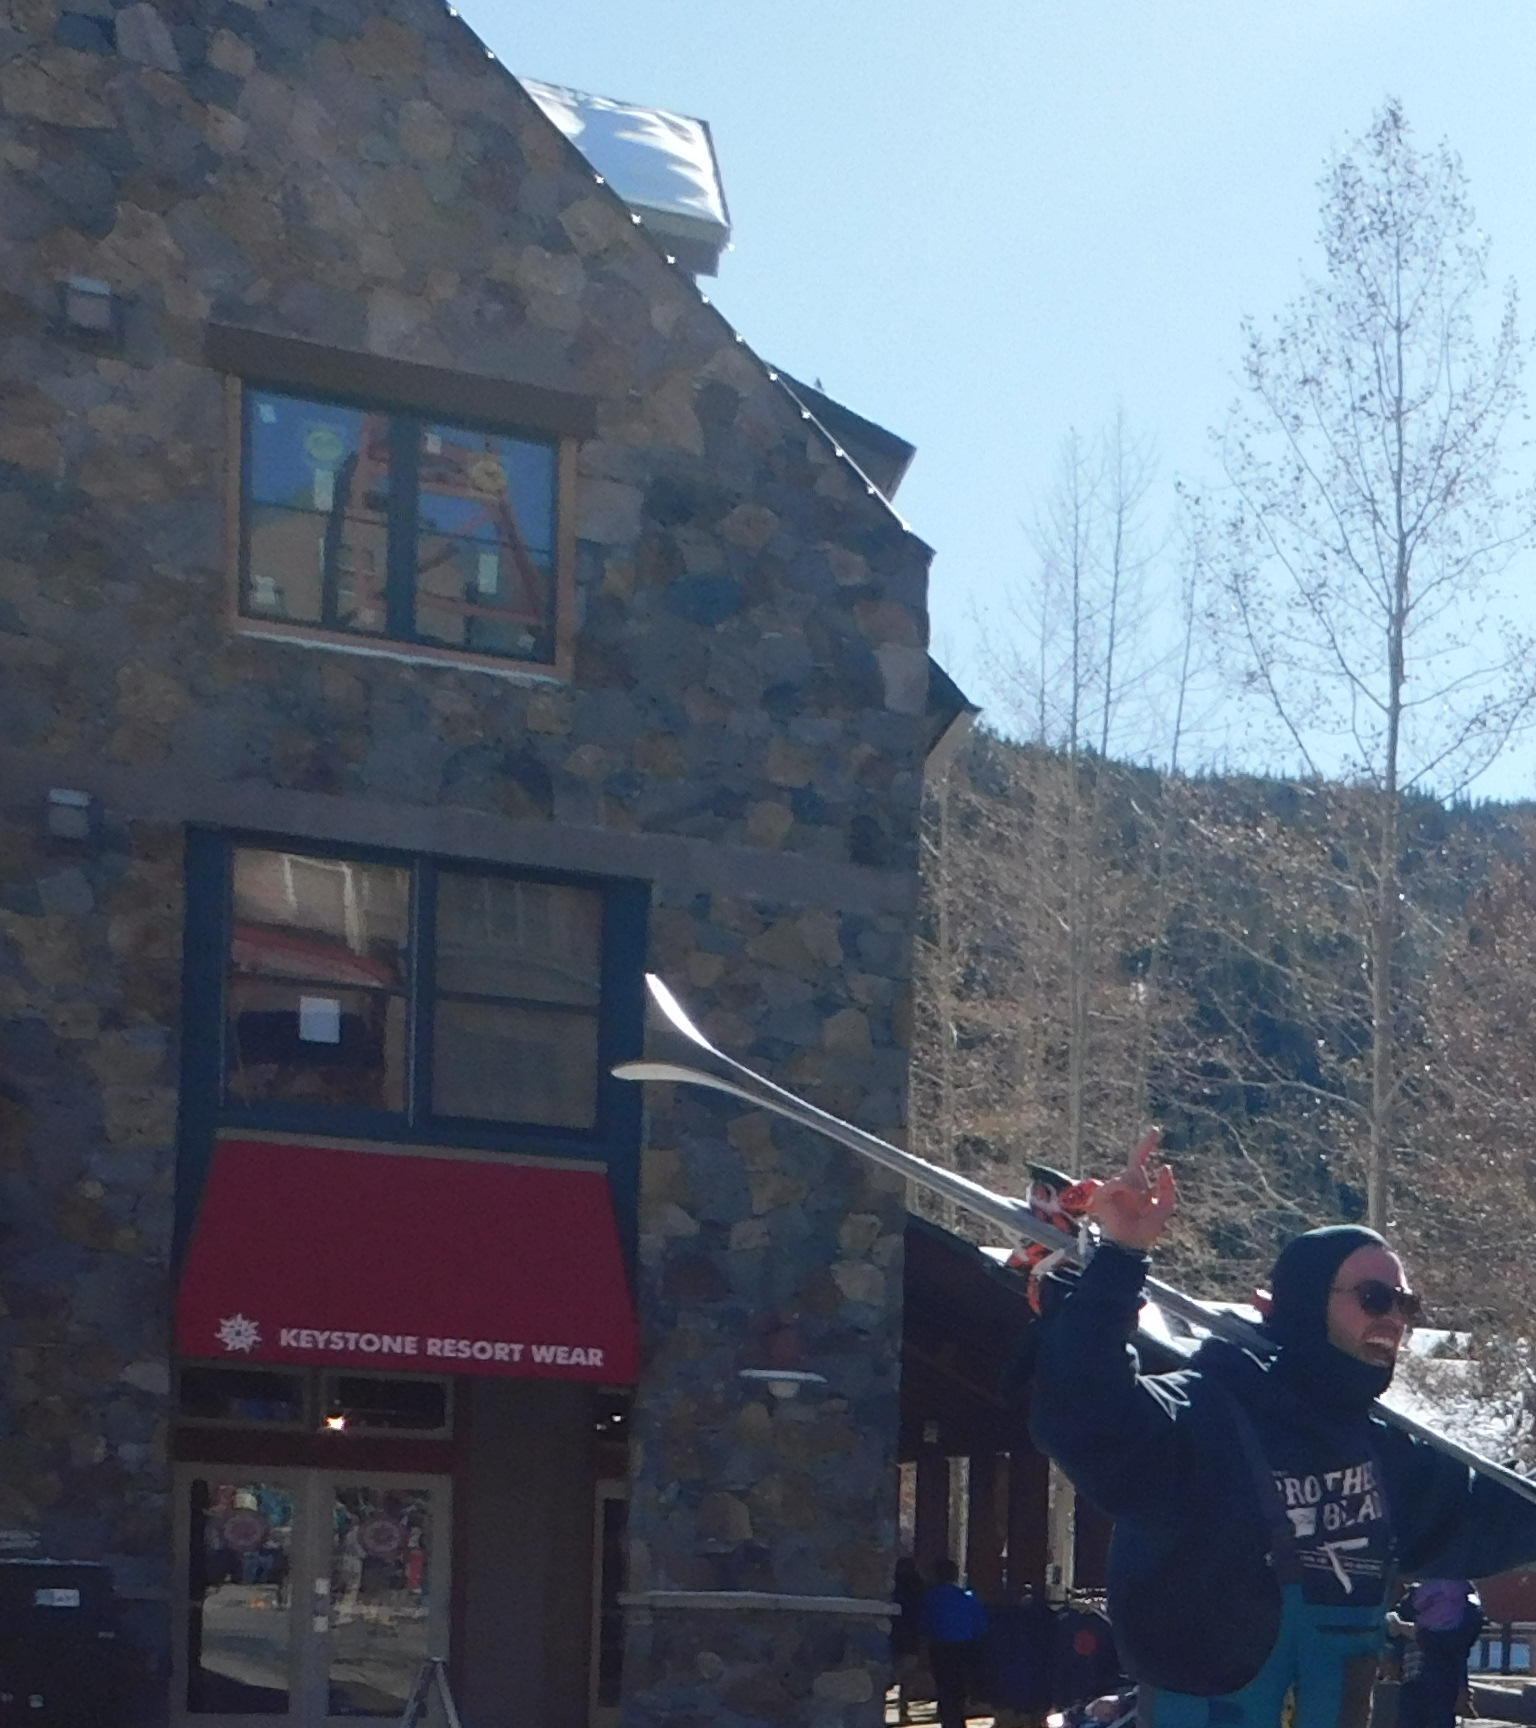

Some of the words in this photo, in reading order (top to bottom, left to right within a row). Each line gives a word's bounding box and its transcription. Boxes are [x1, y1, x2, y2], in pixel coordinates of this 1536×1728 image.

[280, 1327, 418, 1355] KEYSTONE
[426, 1337, 524, 1363] RESORT
[531, 1344, 605, 1367] WEAR
